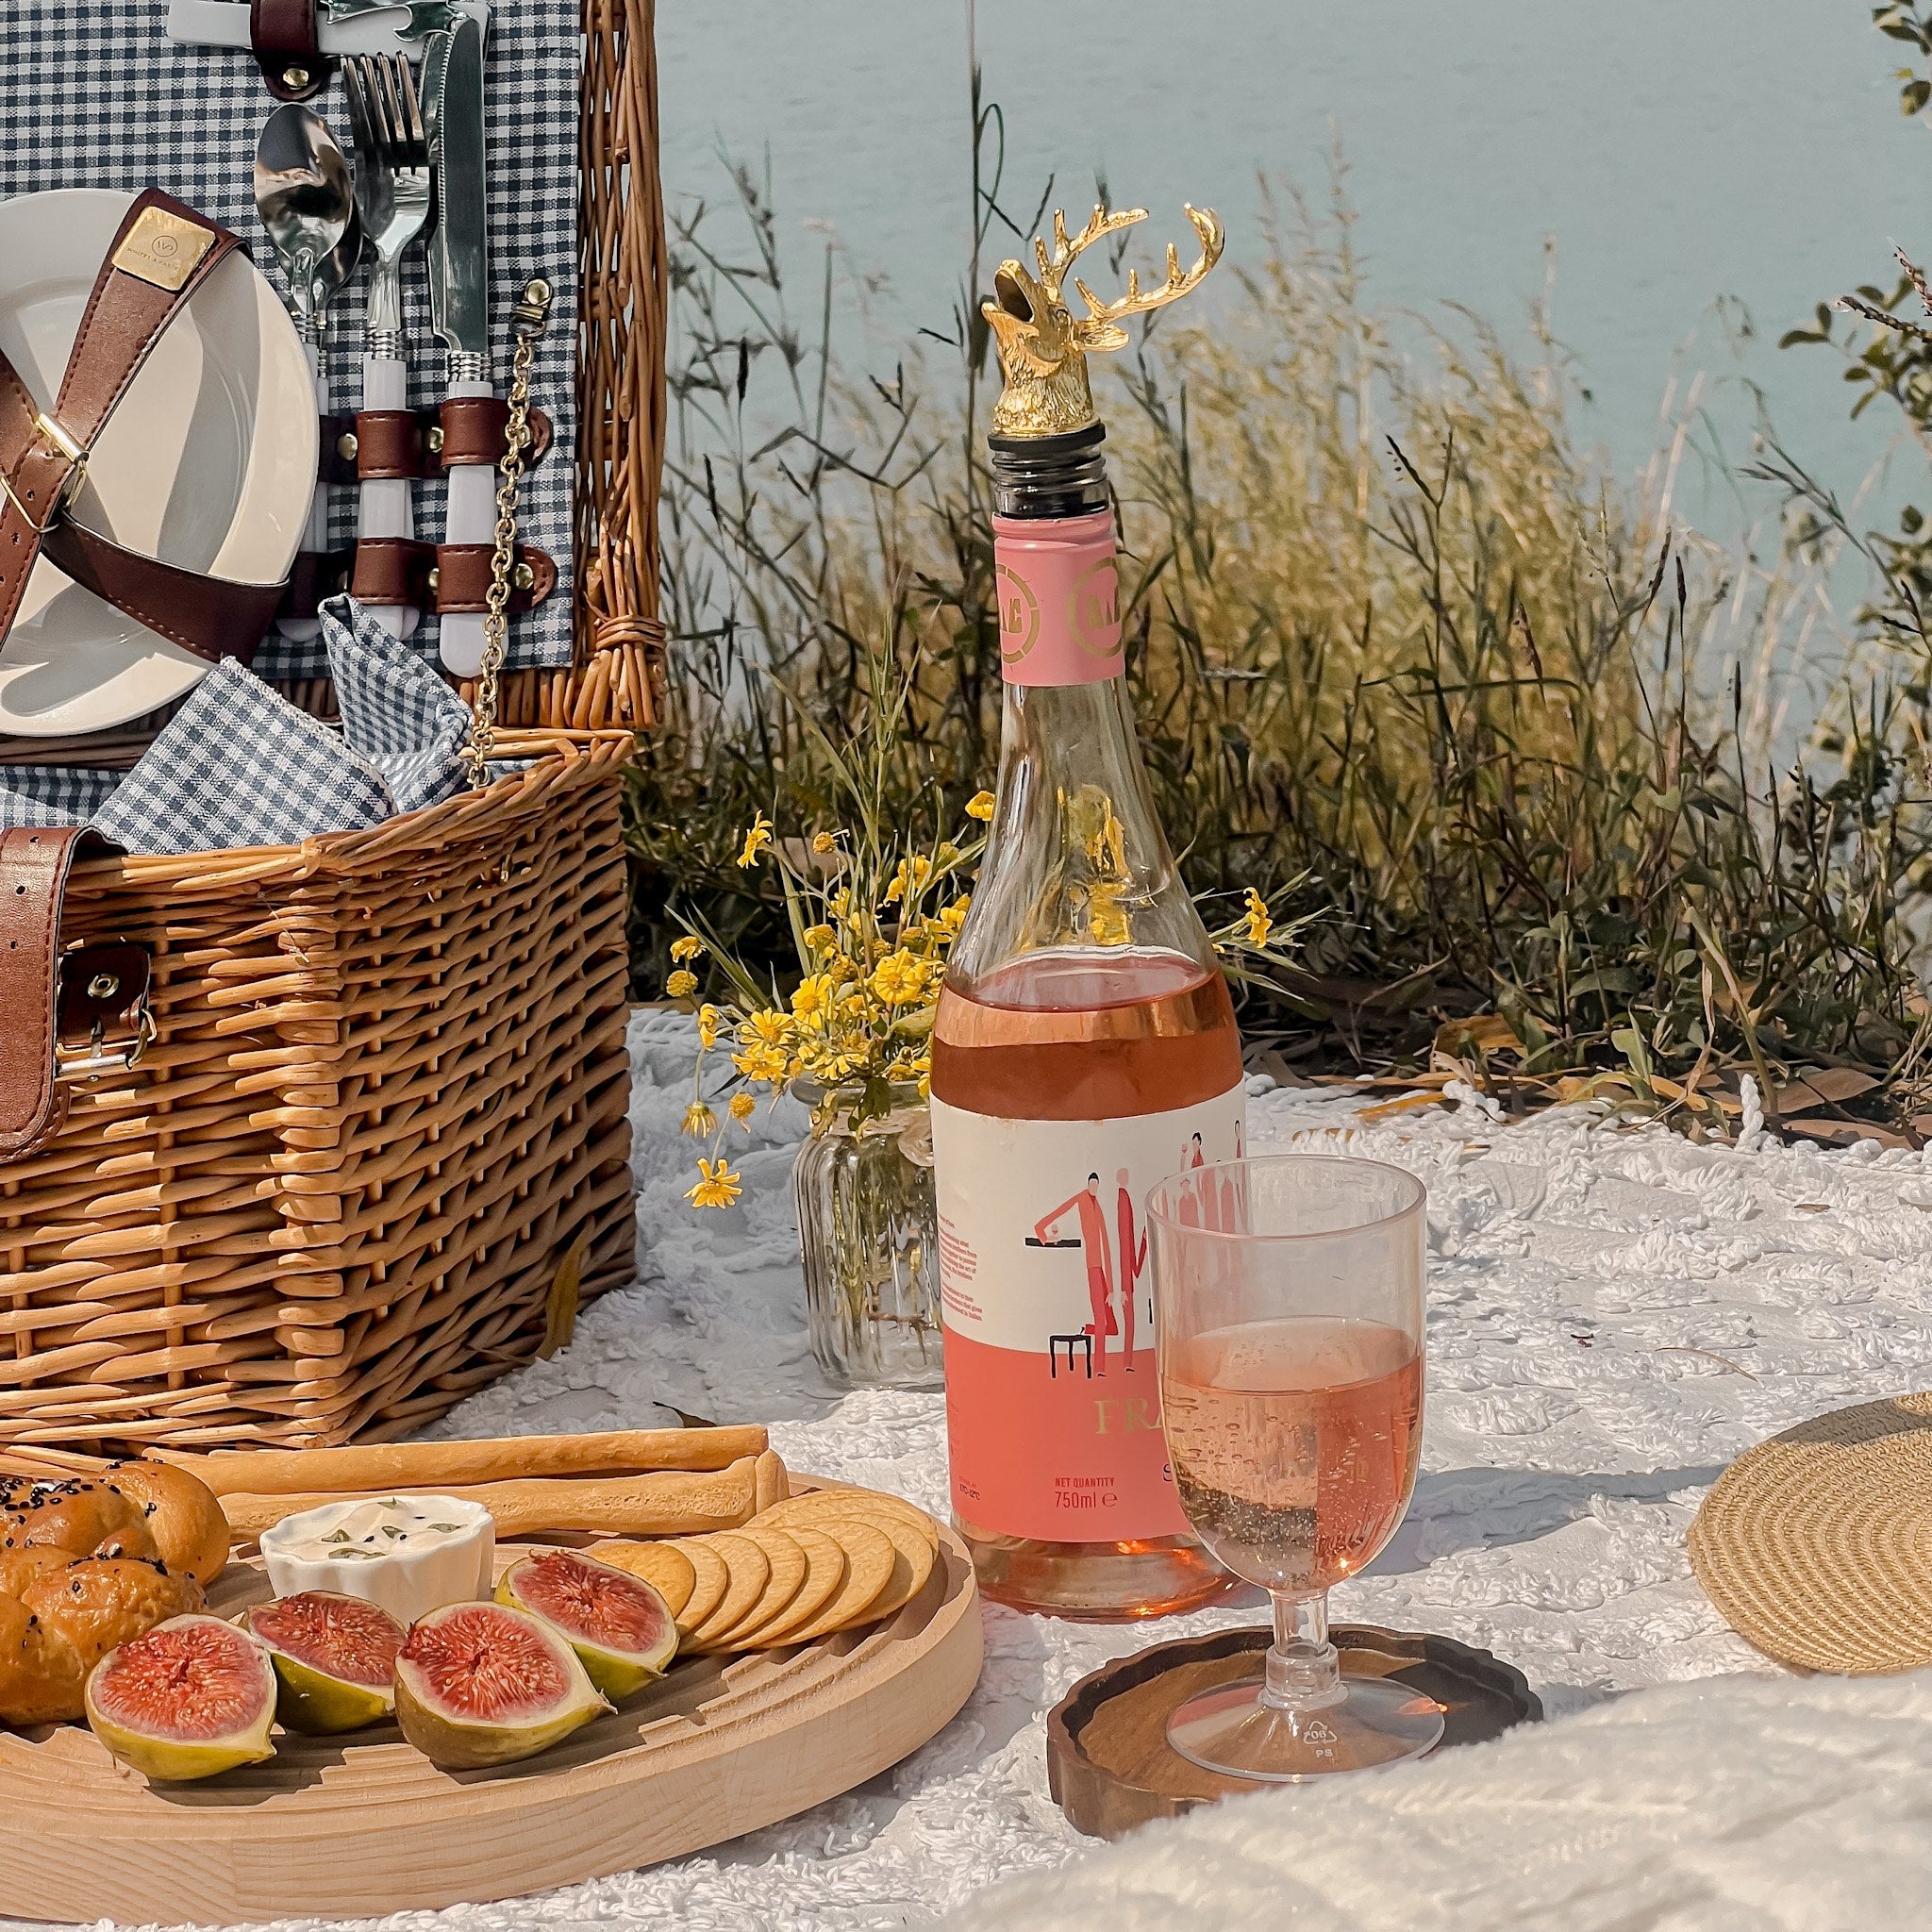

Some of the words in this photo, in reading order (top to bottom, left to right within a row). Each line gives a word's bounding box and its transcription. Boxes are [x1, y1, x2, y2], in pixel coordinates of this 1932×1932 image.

[1056, 1477, 1071, 1488] NET
[1073, 1476, 1116, 1488] QUANTITY
[1055, 1491, 1096, 1508] 750ml
[1311, 1729, 1326, 1740] 06
[1315, 1748, 1333, 1758] PS
